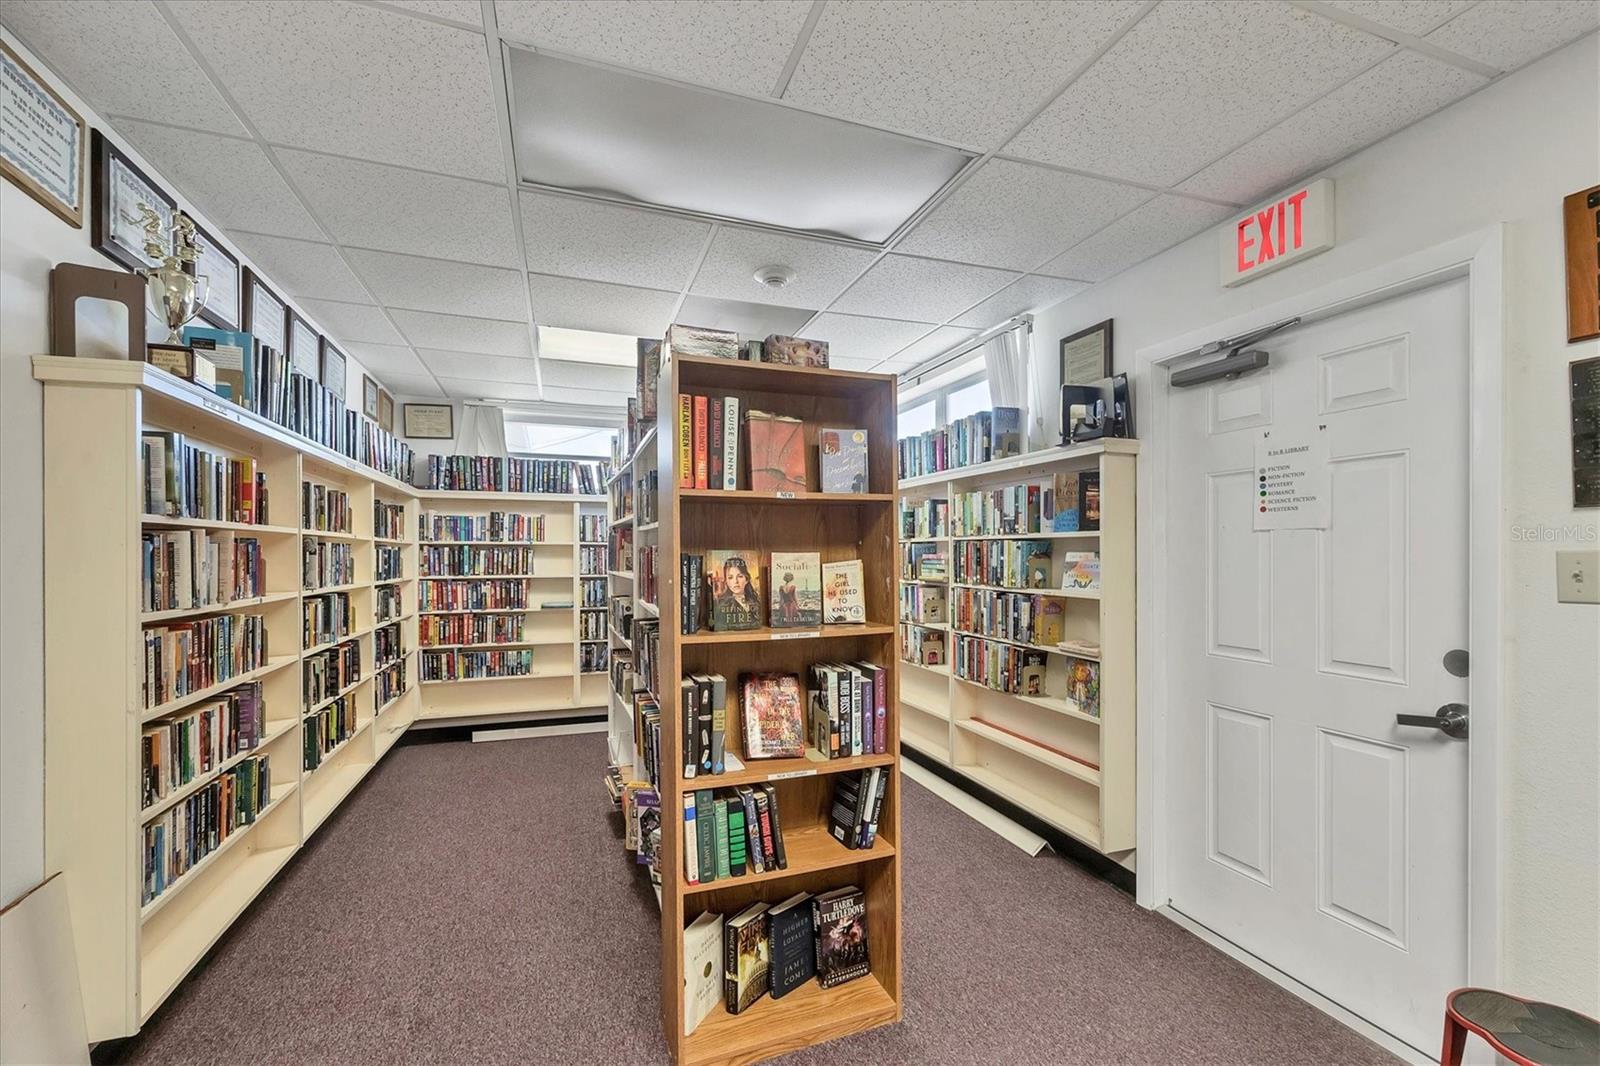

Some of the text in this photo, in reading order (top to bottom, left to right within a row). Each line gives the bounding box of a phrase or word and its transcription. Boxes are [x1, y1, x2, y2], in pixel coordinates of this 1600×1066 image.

[1237, 190, 1308, 273] EXIT
[682, 396, 690, 424] HARLAN
[682, 425, 690, 447] COBEN
[727, 404, 735, 476] LOUISE PENNY
[1268, 472, 1305, 480] NON-FICTION
[726, 613, 752, 623] FIRE
[764, 680, 777, 689] THE
[840, 680, 850, 714] MOB BOSS
[760, 811, 773, 856] TOUGH GUYS
[822, 903, 865, 923] TURTLEDOVE
[833, 898, 854, 911] HARRY
